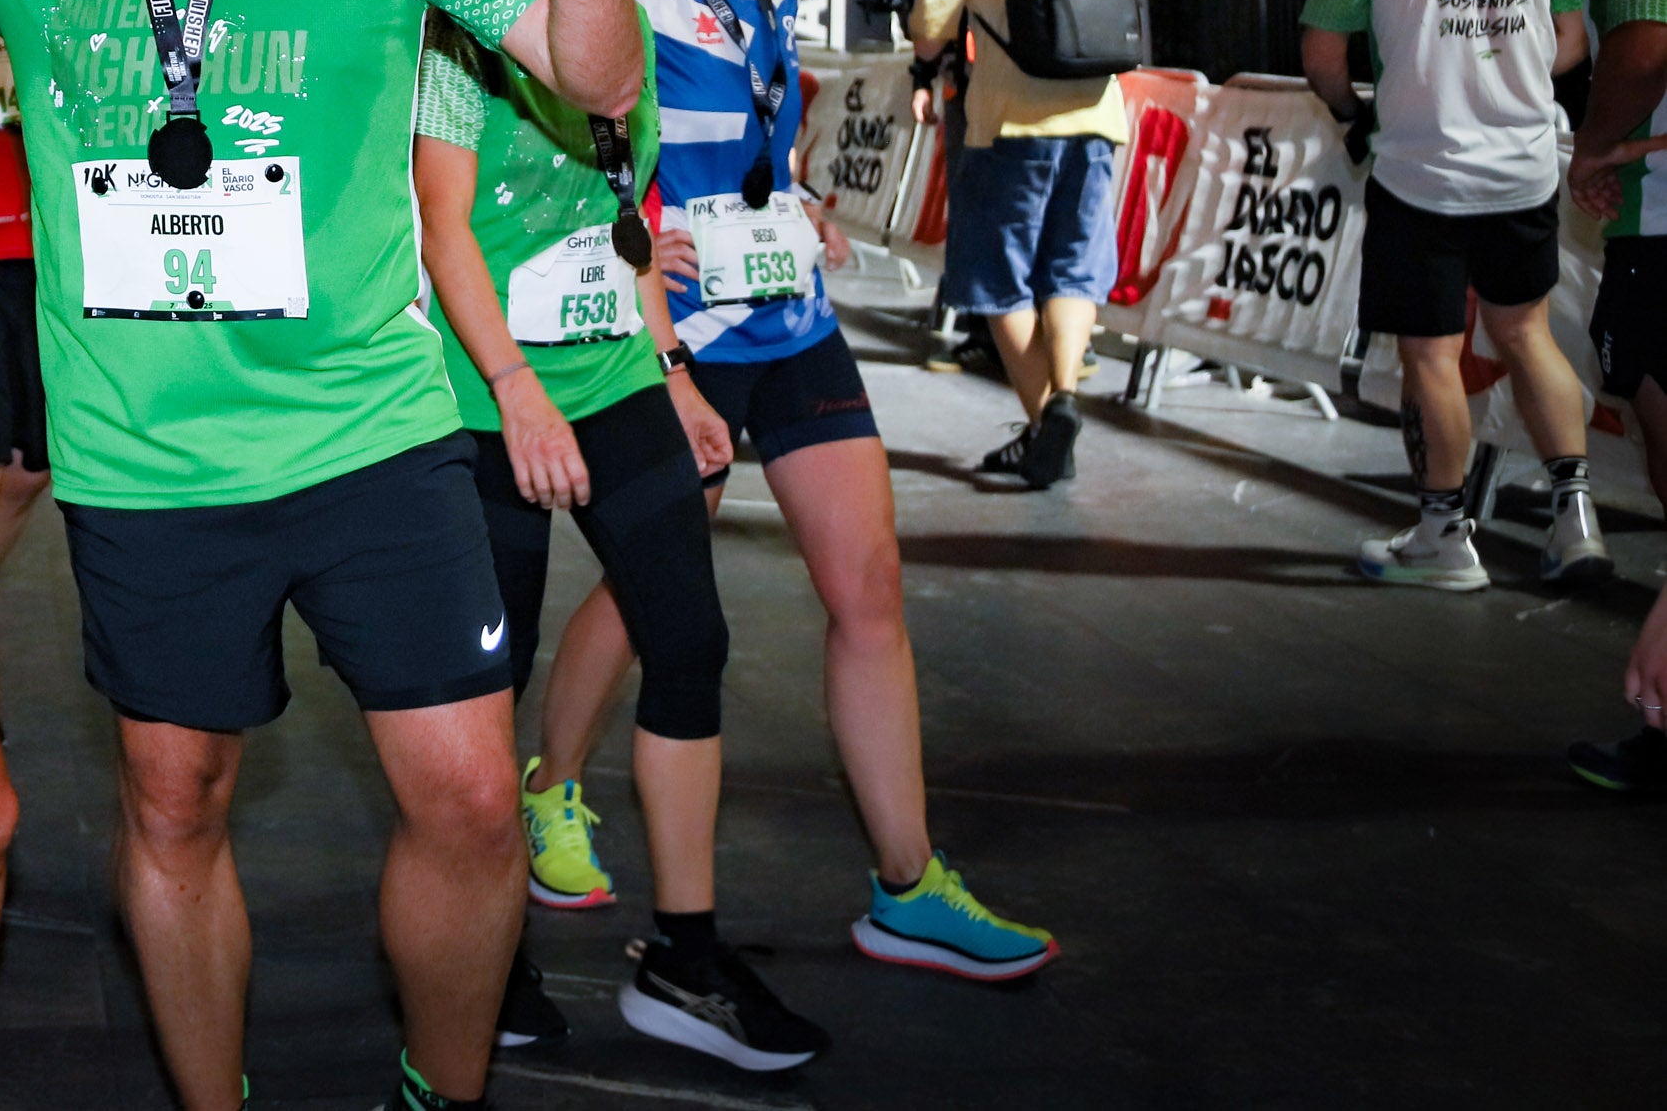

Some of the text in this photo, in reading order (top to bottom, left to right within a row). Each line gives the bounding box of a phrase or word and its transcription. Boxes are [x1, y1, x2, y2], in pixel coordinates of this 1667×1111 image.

[222, 105, 284, 136] 2025
[1244, 127, 1278, 177] EL
[222, 168, 232, 176] EL
[222, 175, 254, 184] DIARIO
[279, 171, 291, 195] 2
[223, 184, 254, 192] VASCO
[150, 214, 224, 236] ALBERTO
[752, 228, 777, 243] BEGO
[568, 234, 611, 253] GHTRUN
[163, 248, 217, 295] 94
[581, 265, 605, 283] LEIRE
[743, 250, 797, 285] F533
[560, 289, 617, 328] F538
